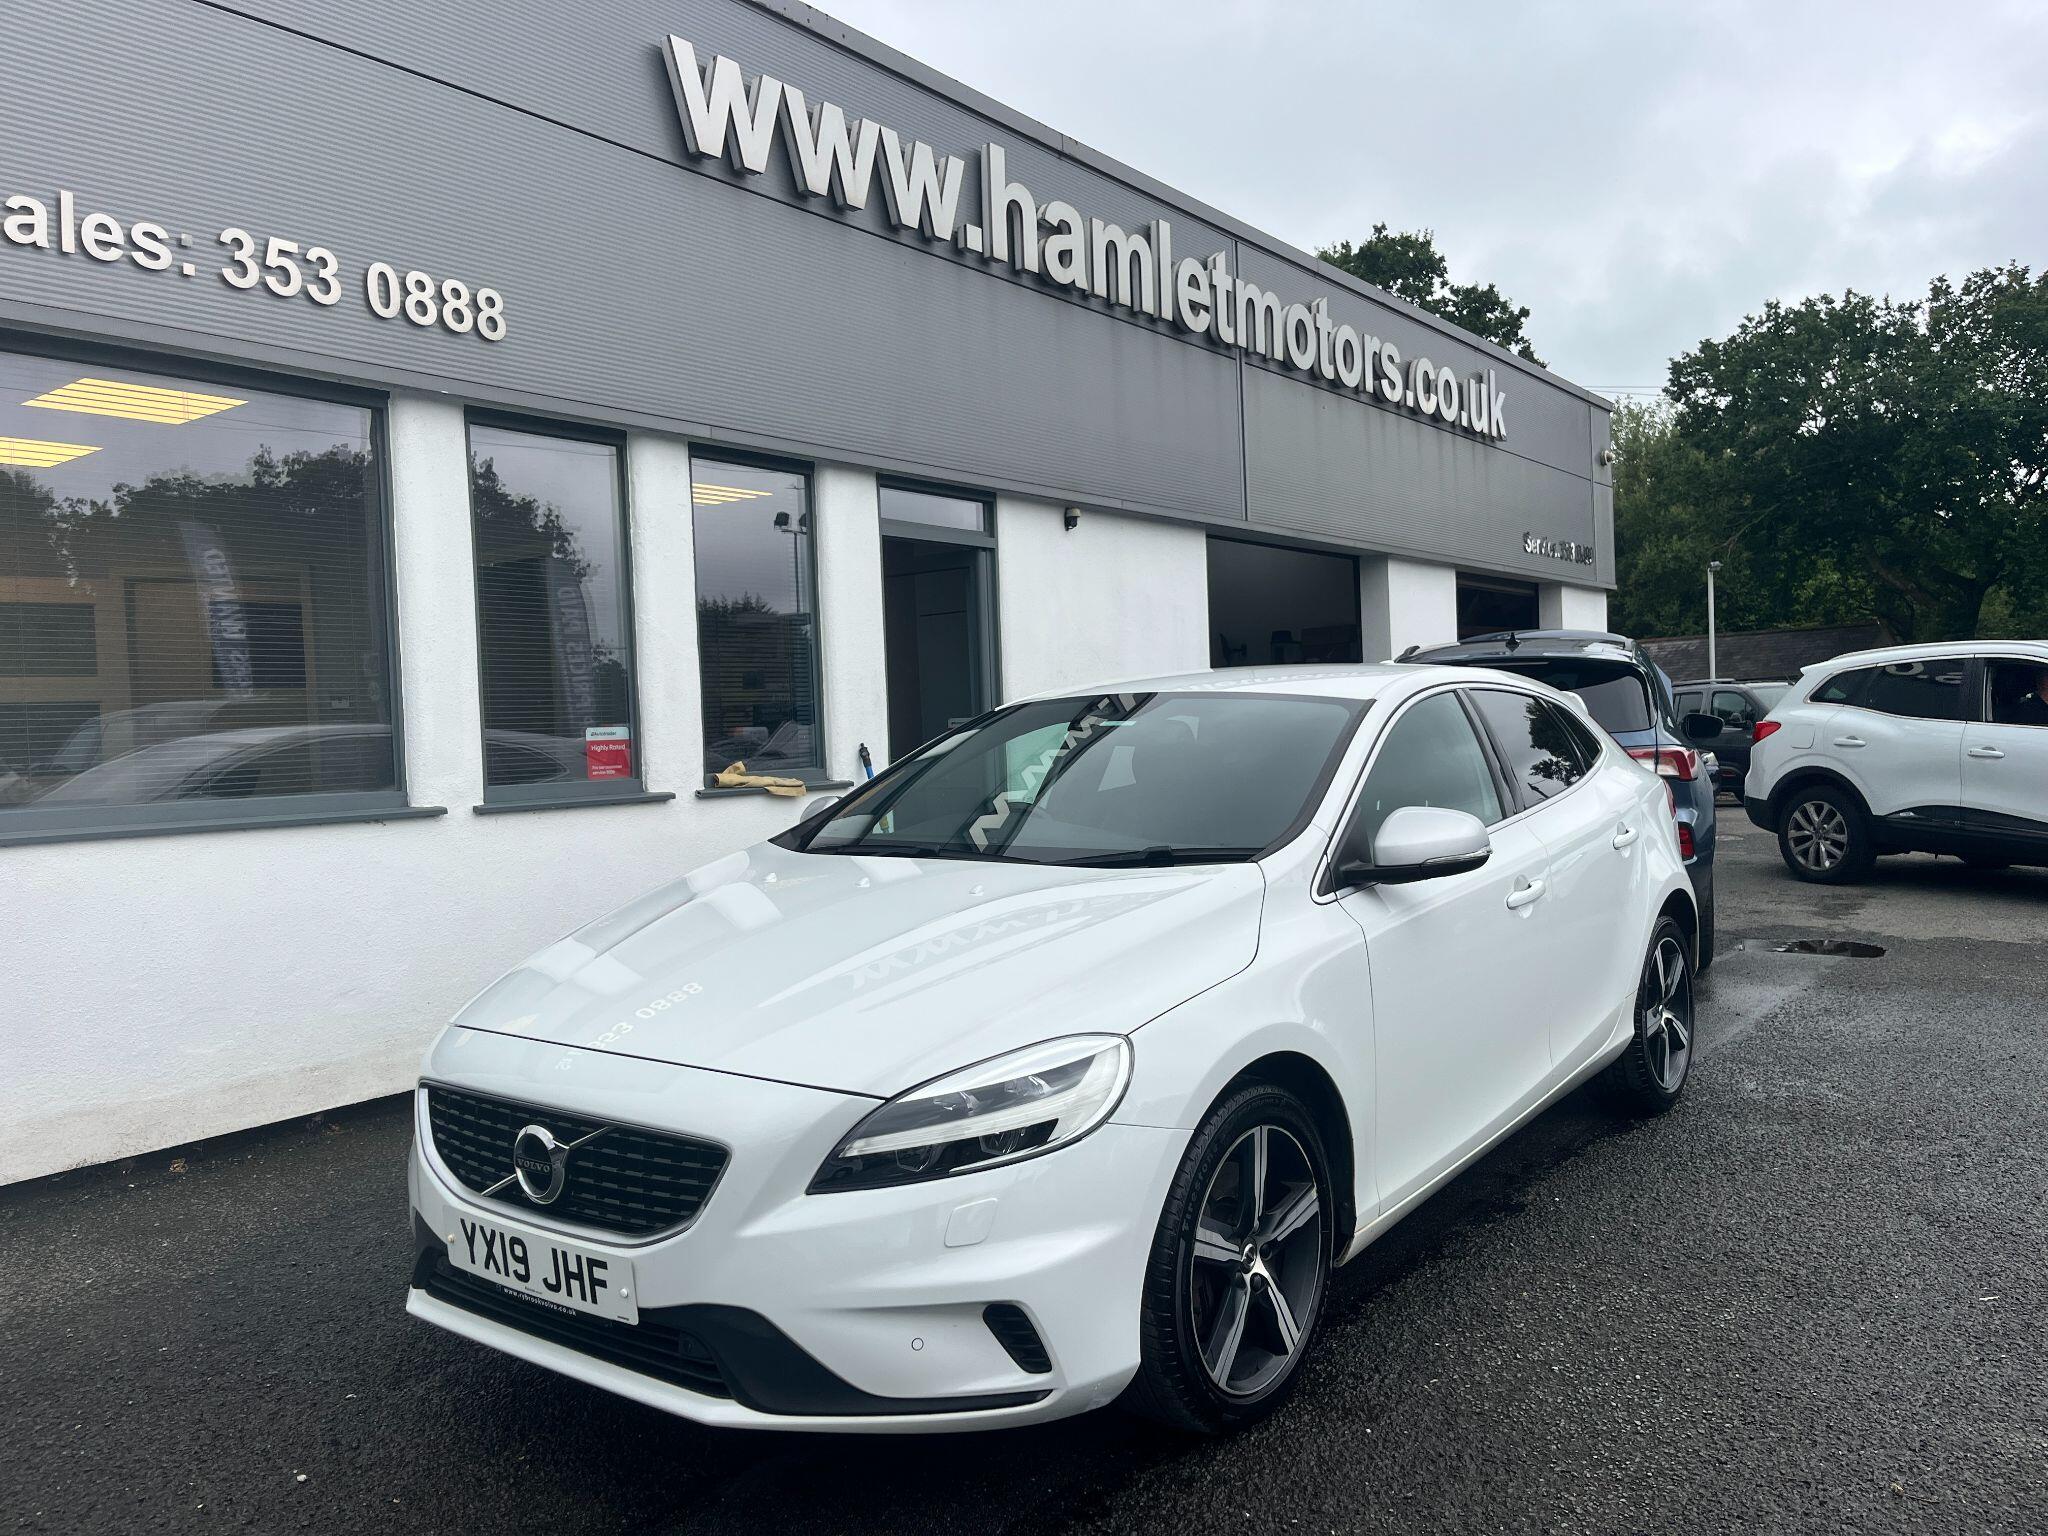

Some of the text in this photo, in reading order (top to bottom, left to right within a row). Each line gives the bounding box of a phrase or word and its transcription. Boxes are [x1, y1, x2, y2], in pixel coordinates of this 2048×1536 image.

[218, 227, 342, 306] 353
[366, 261, 507, 342] 0888
[660, 34, 1507, 441] www.hamletmotors.co.uk
[516, 1158, 550, 1173] VOLVO
[460, 1217, 608, 1305] YX19 JHF
